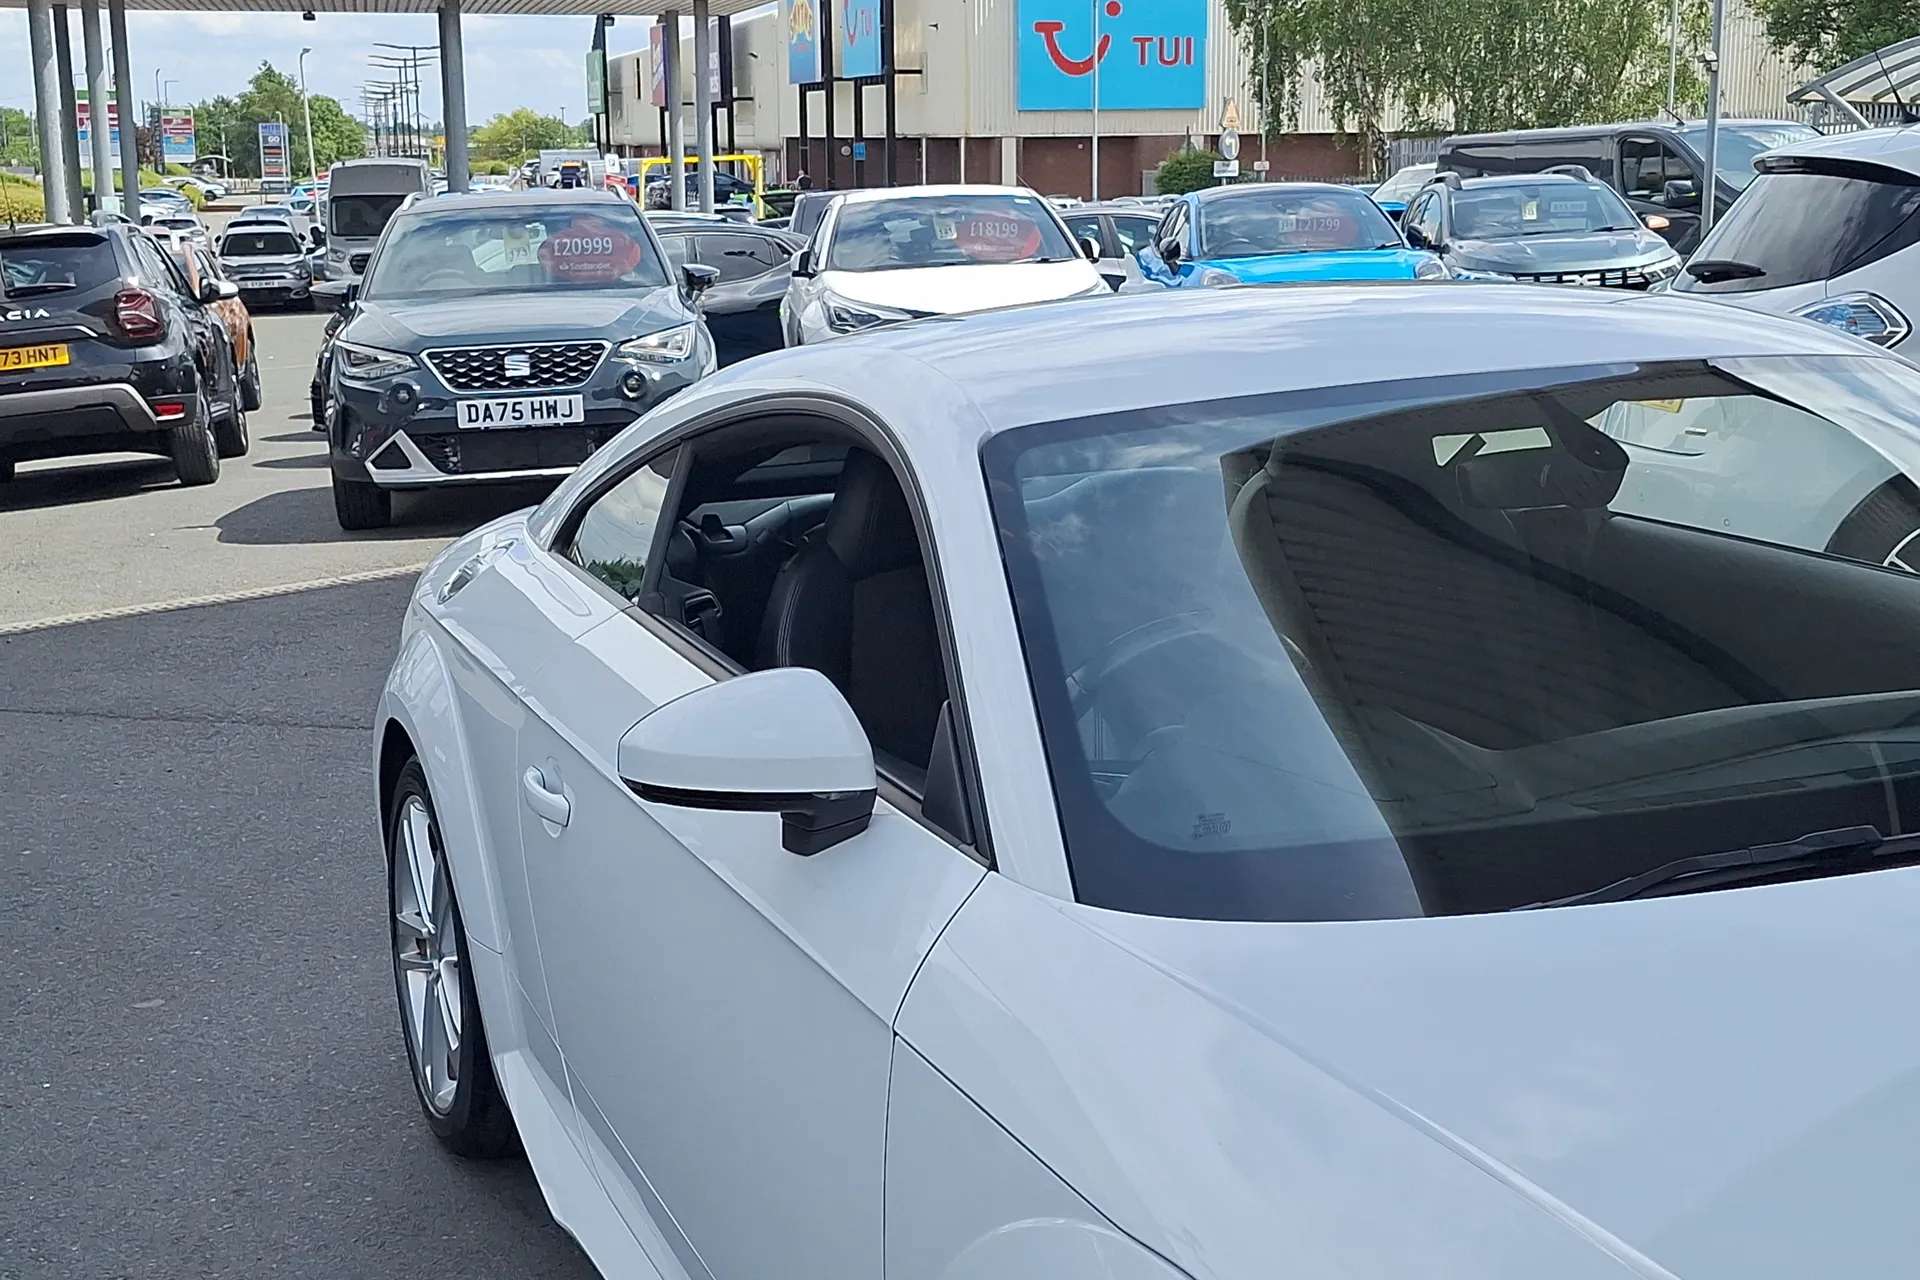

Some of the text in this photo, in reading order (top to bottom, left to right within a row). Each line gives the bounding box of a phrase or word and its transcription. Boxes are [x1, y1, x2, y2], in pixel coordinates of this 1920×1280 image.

[1132, 36, 1193, 66] TUI
[969, 221, 1018, 238] £18199
[553, 237, 613, 256] £20999
[26, 346, 60, 364] HNT
[466, 399, 573, 423] DA75 HWJ
